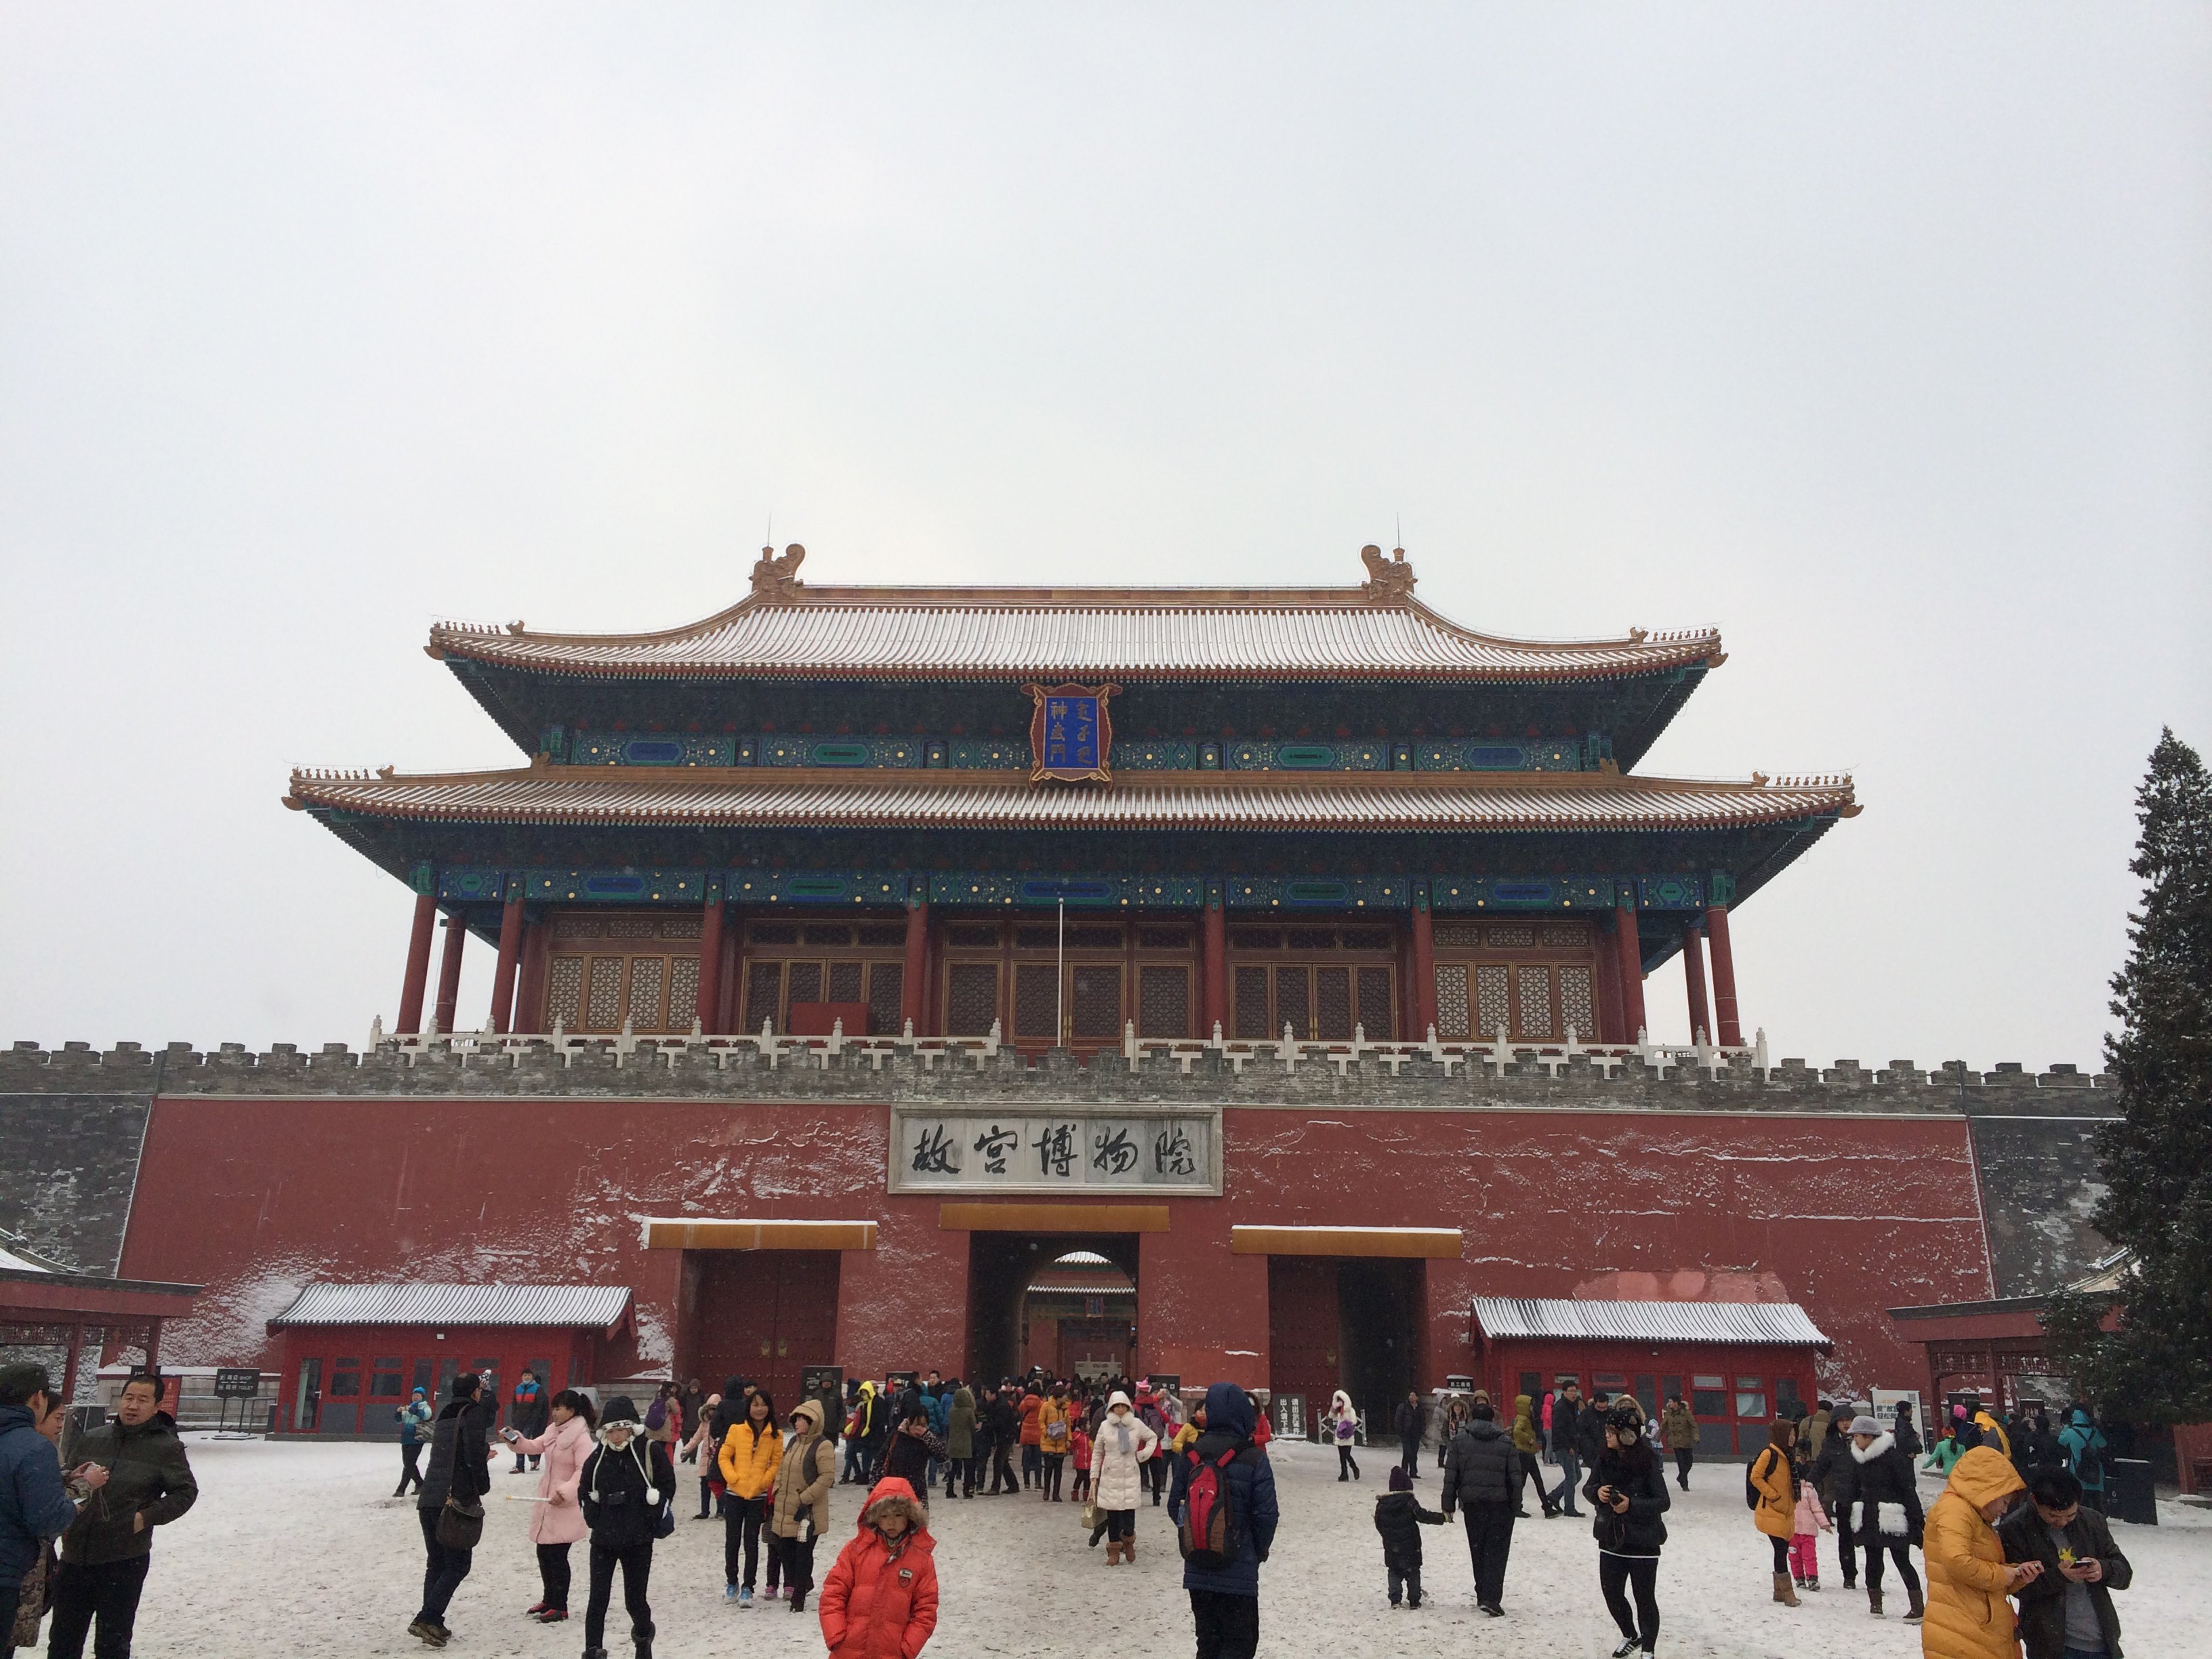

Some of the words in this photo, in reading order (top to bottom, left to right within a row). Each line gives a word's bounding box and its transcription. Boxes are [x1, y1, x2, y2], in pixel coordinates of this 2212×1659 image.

[912, 1124, 1195, 1177] 故宫博物院
